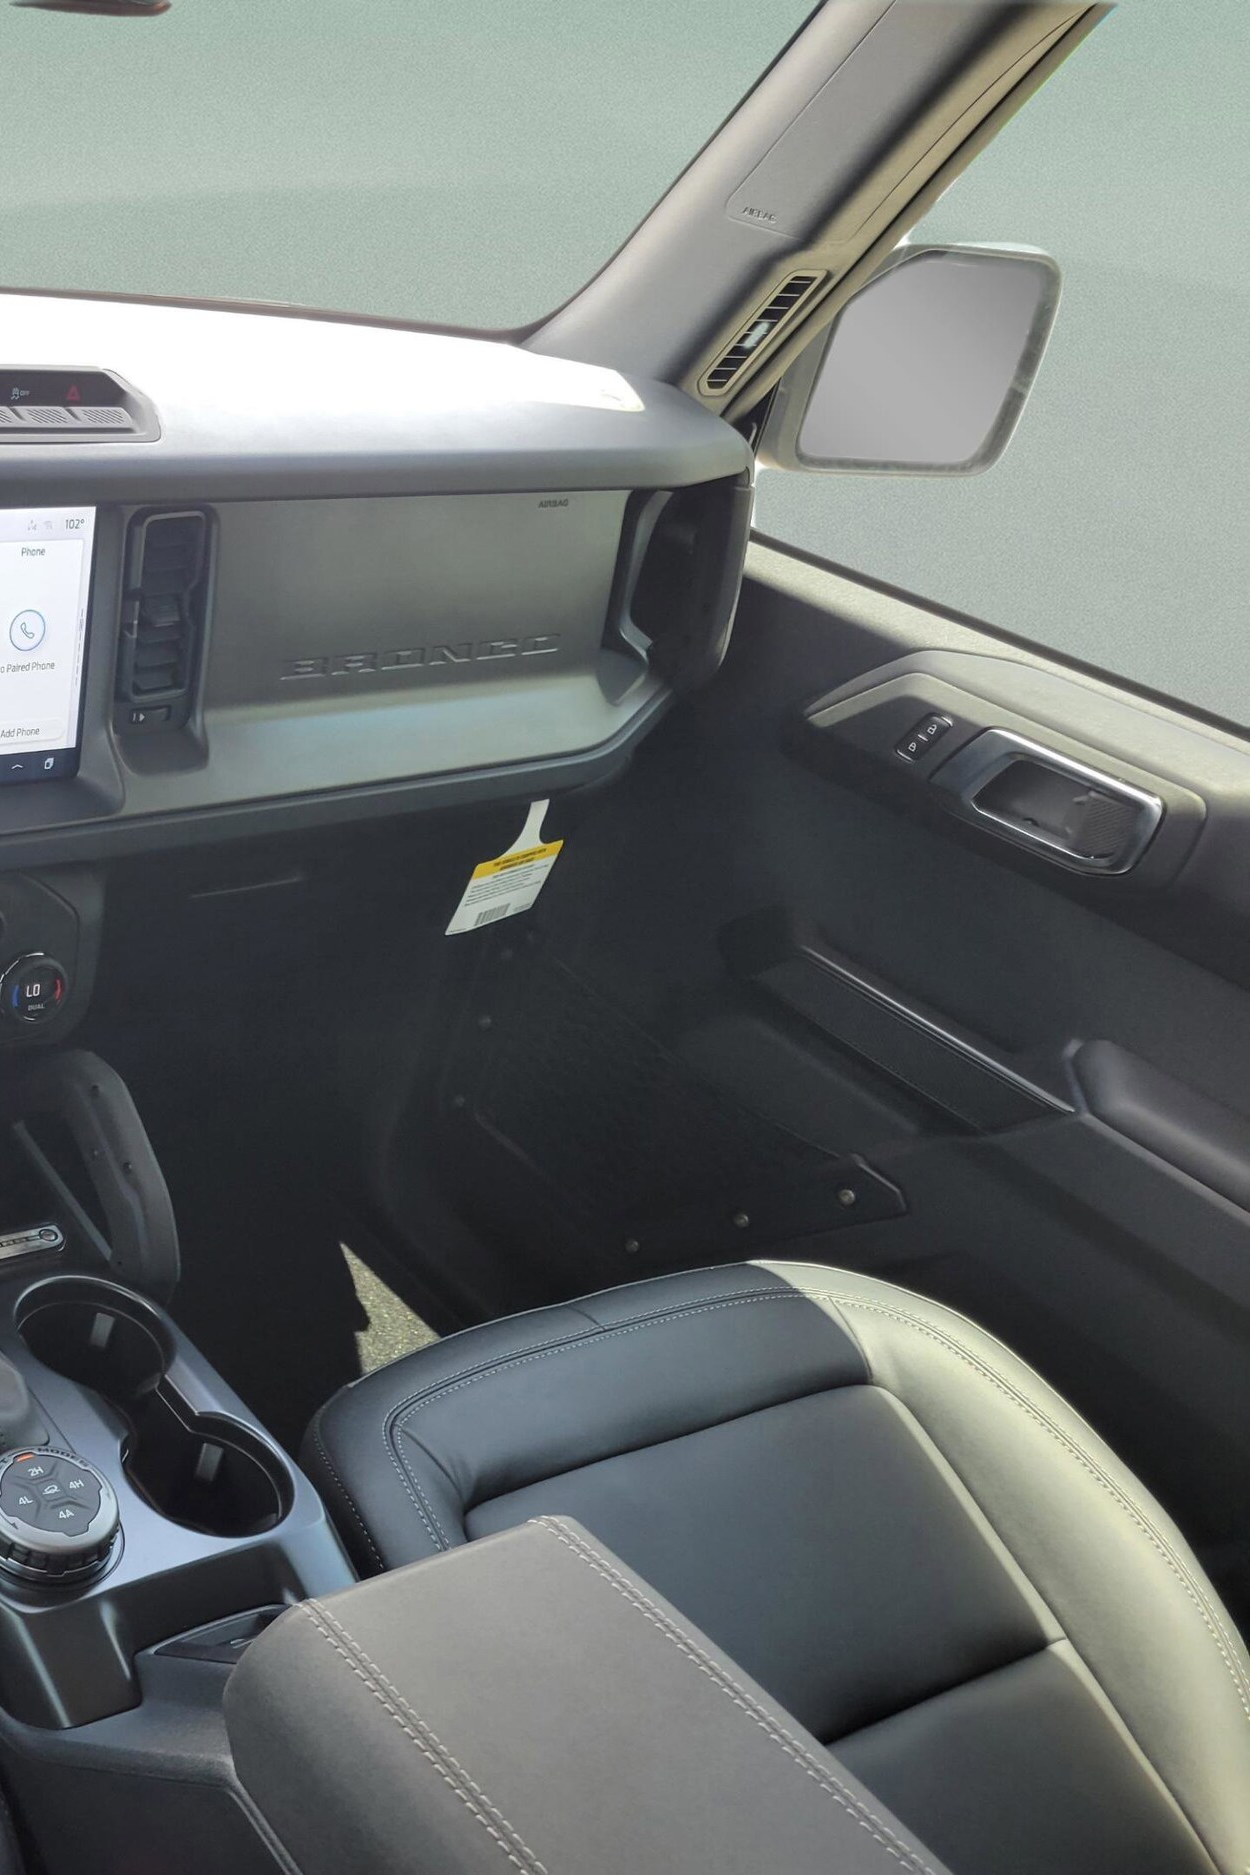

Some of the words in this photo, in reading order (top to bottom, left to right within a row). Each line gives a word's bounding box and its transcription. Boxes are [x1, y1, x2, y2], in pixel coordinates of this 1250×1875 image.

[21, 548, 46, 556] Phone
[7, 662, 30, 672] Paired
[31, 661, 55, 671] Phone
[0, 729, 15, 739] Add
[16, 727, 40, 737] Phone
[26, 983, 41, 998] LO
[27, 1003, 45, 1011] DUAL
[27, 1466, 45, 1477] 2H
[69, 1479, 85, 1490] 4H
[18, 1496, 34, 1506] 4L
[58, 1508, 75, 1520] 4A
